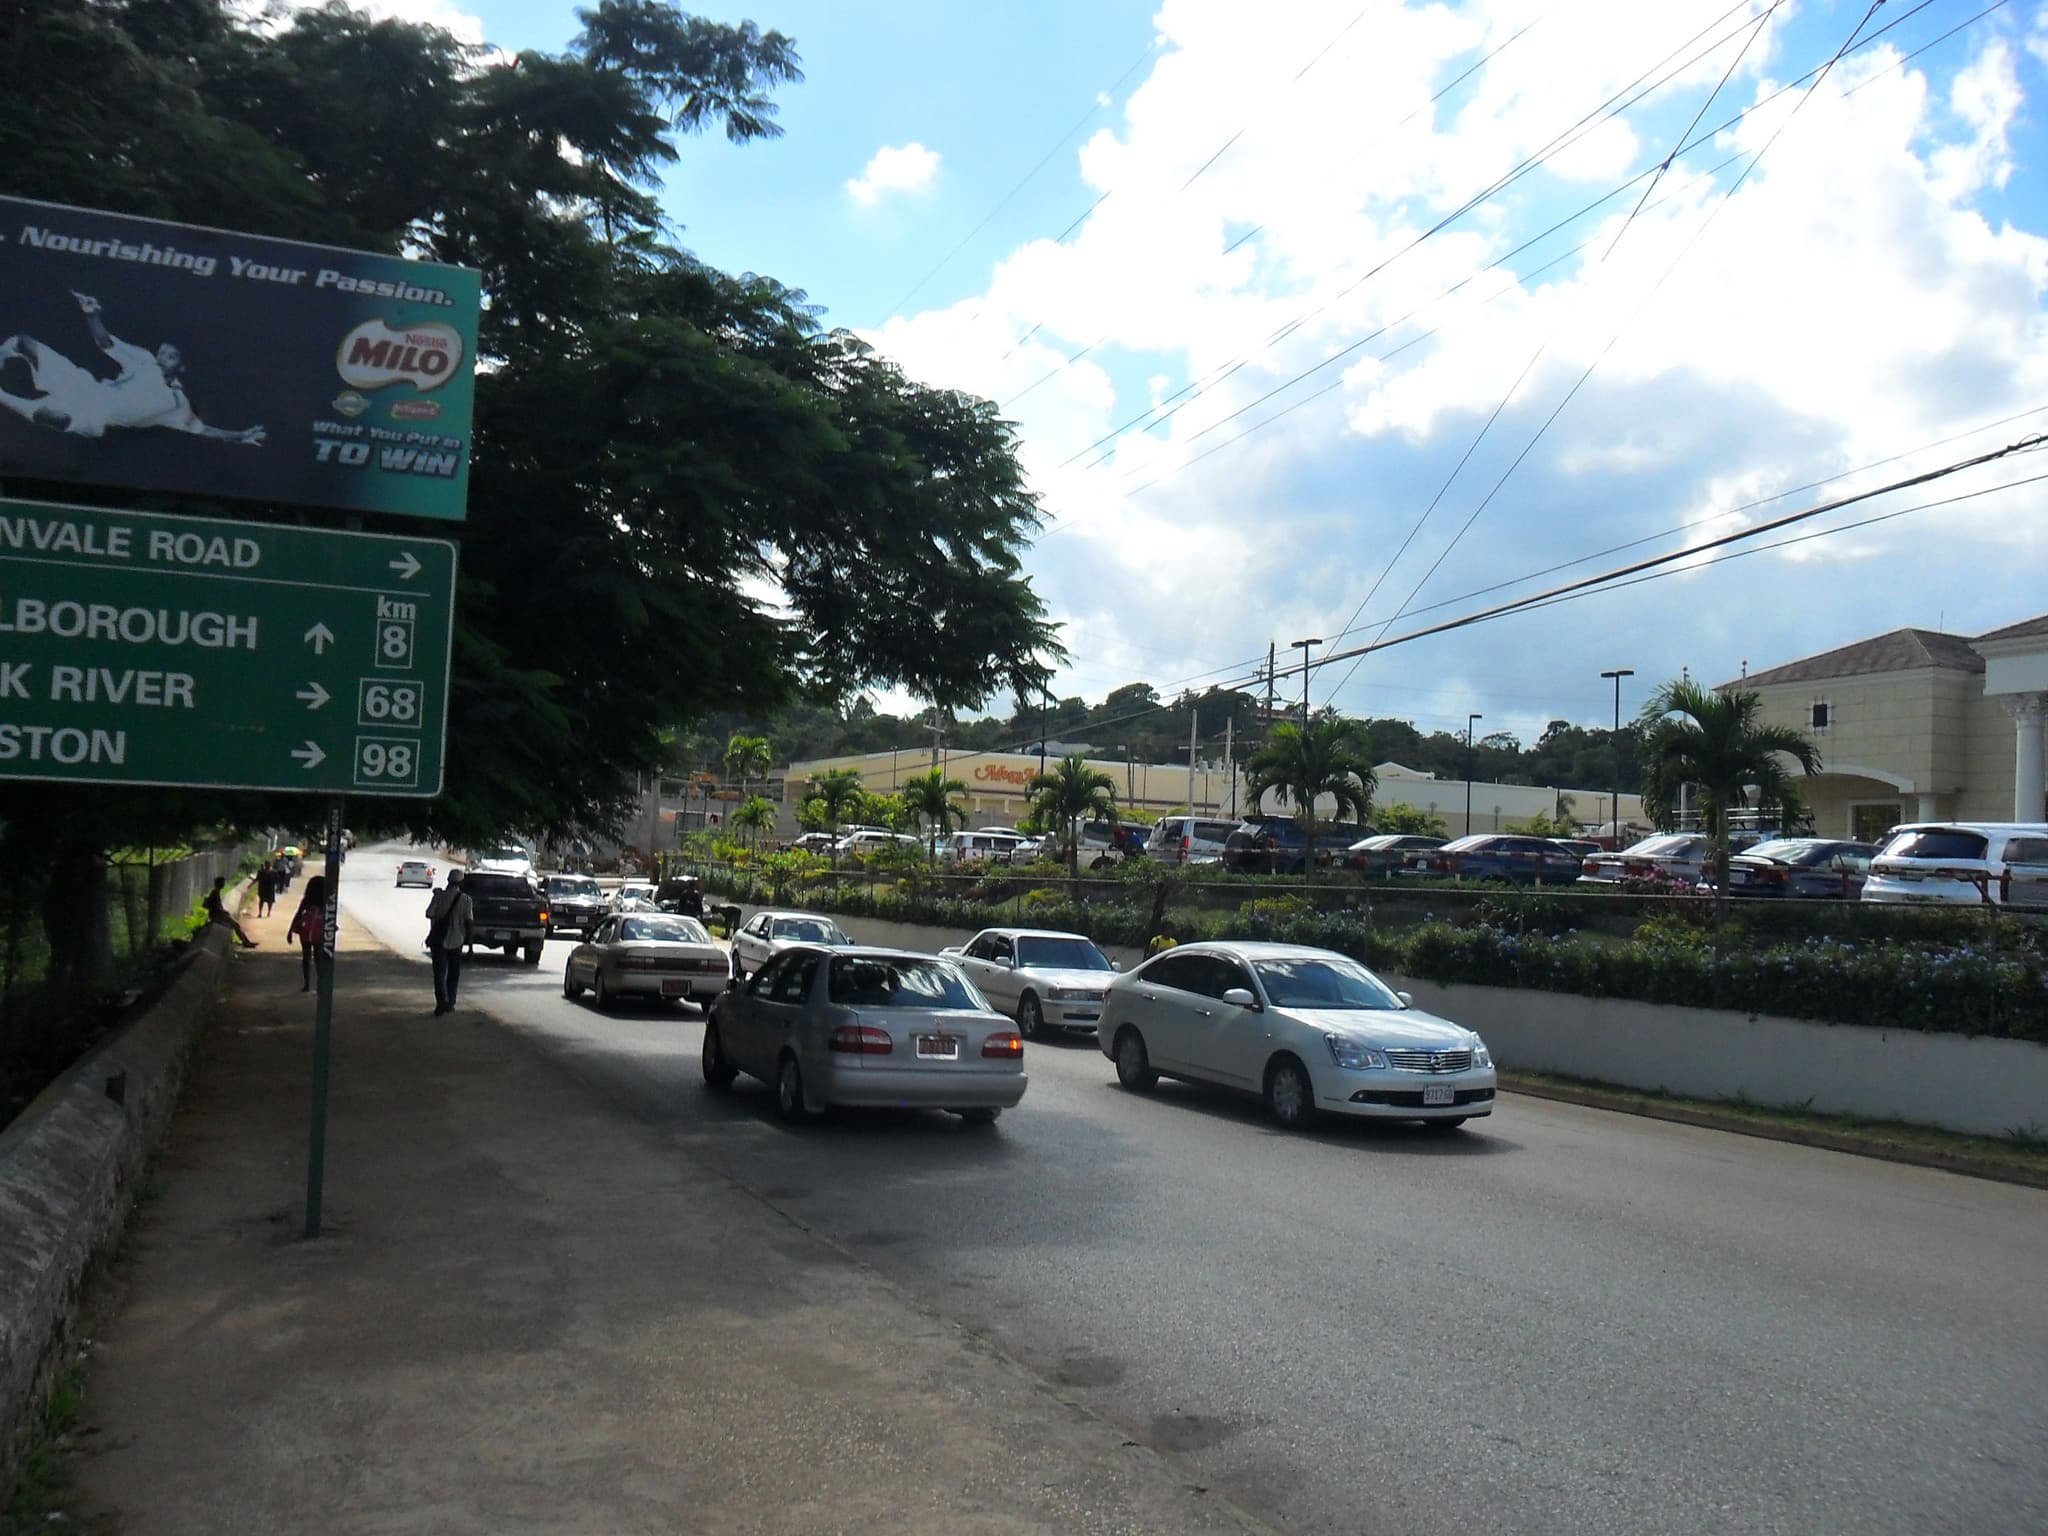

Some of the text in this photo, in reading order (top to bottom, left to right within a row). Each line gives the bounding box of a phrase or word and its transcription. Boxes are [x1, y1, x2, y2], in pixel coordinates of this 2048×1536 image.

[20, 226, 453, 306] Nourishing Your Passion.
[348, 337, 449, 376] MILO
[313, 420, 363, 437] What
[370, 426, 402, 442] You
[407, 431, 440, 446] Put
[313, 440, 371, 465] TO
[0, 516, 260, 568] NVALE ROAD
[376, 595, 416, 620] km
[383, 625, 407, 659] 8
[0, 661, 195, 708] K RIVER
[364, 685, 416, 720] 68
[0, 724, 126, 764] STON
[362, 743, 411, 778] 98
